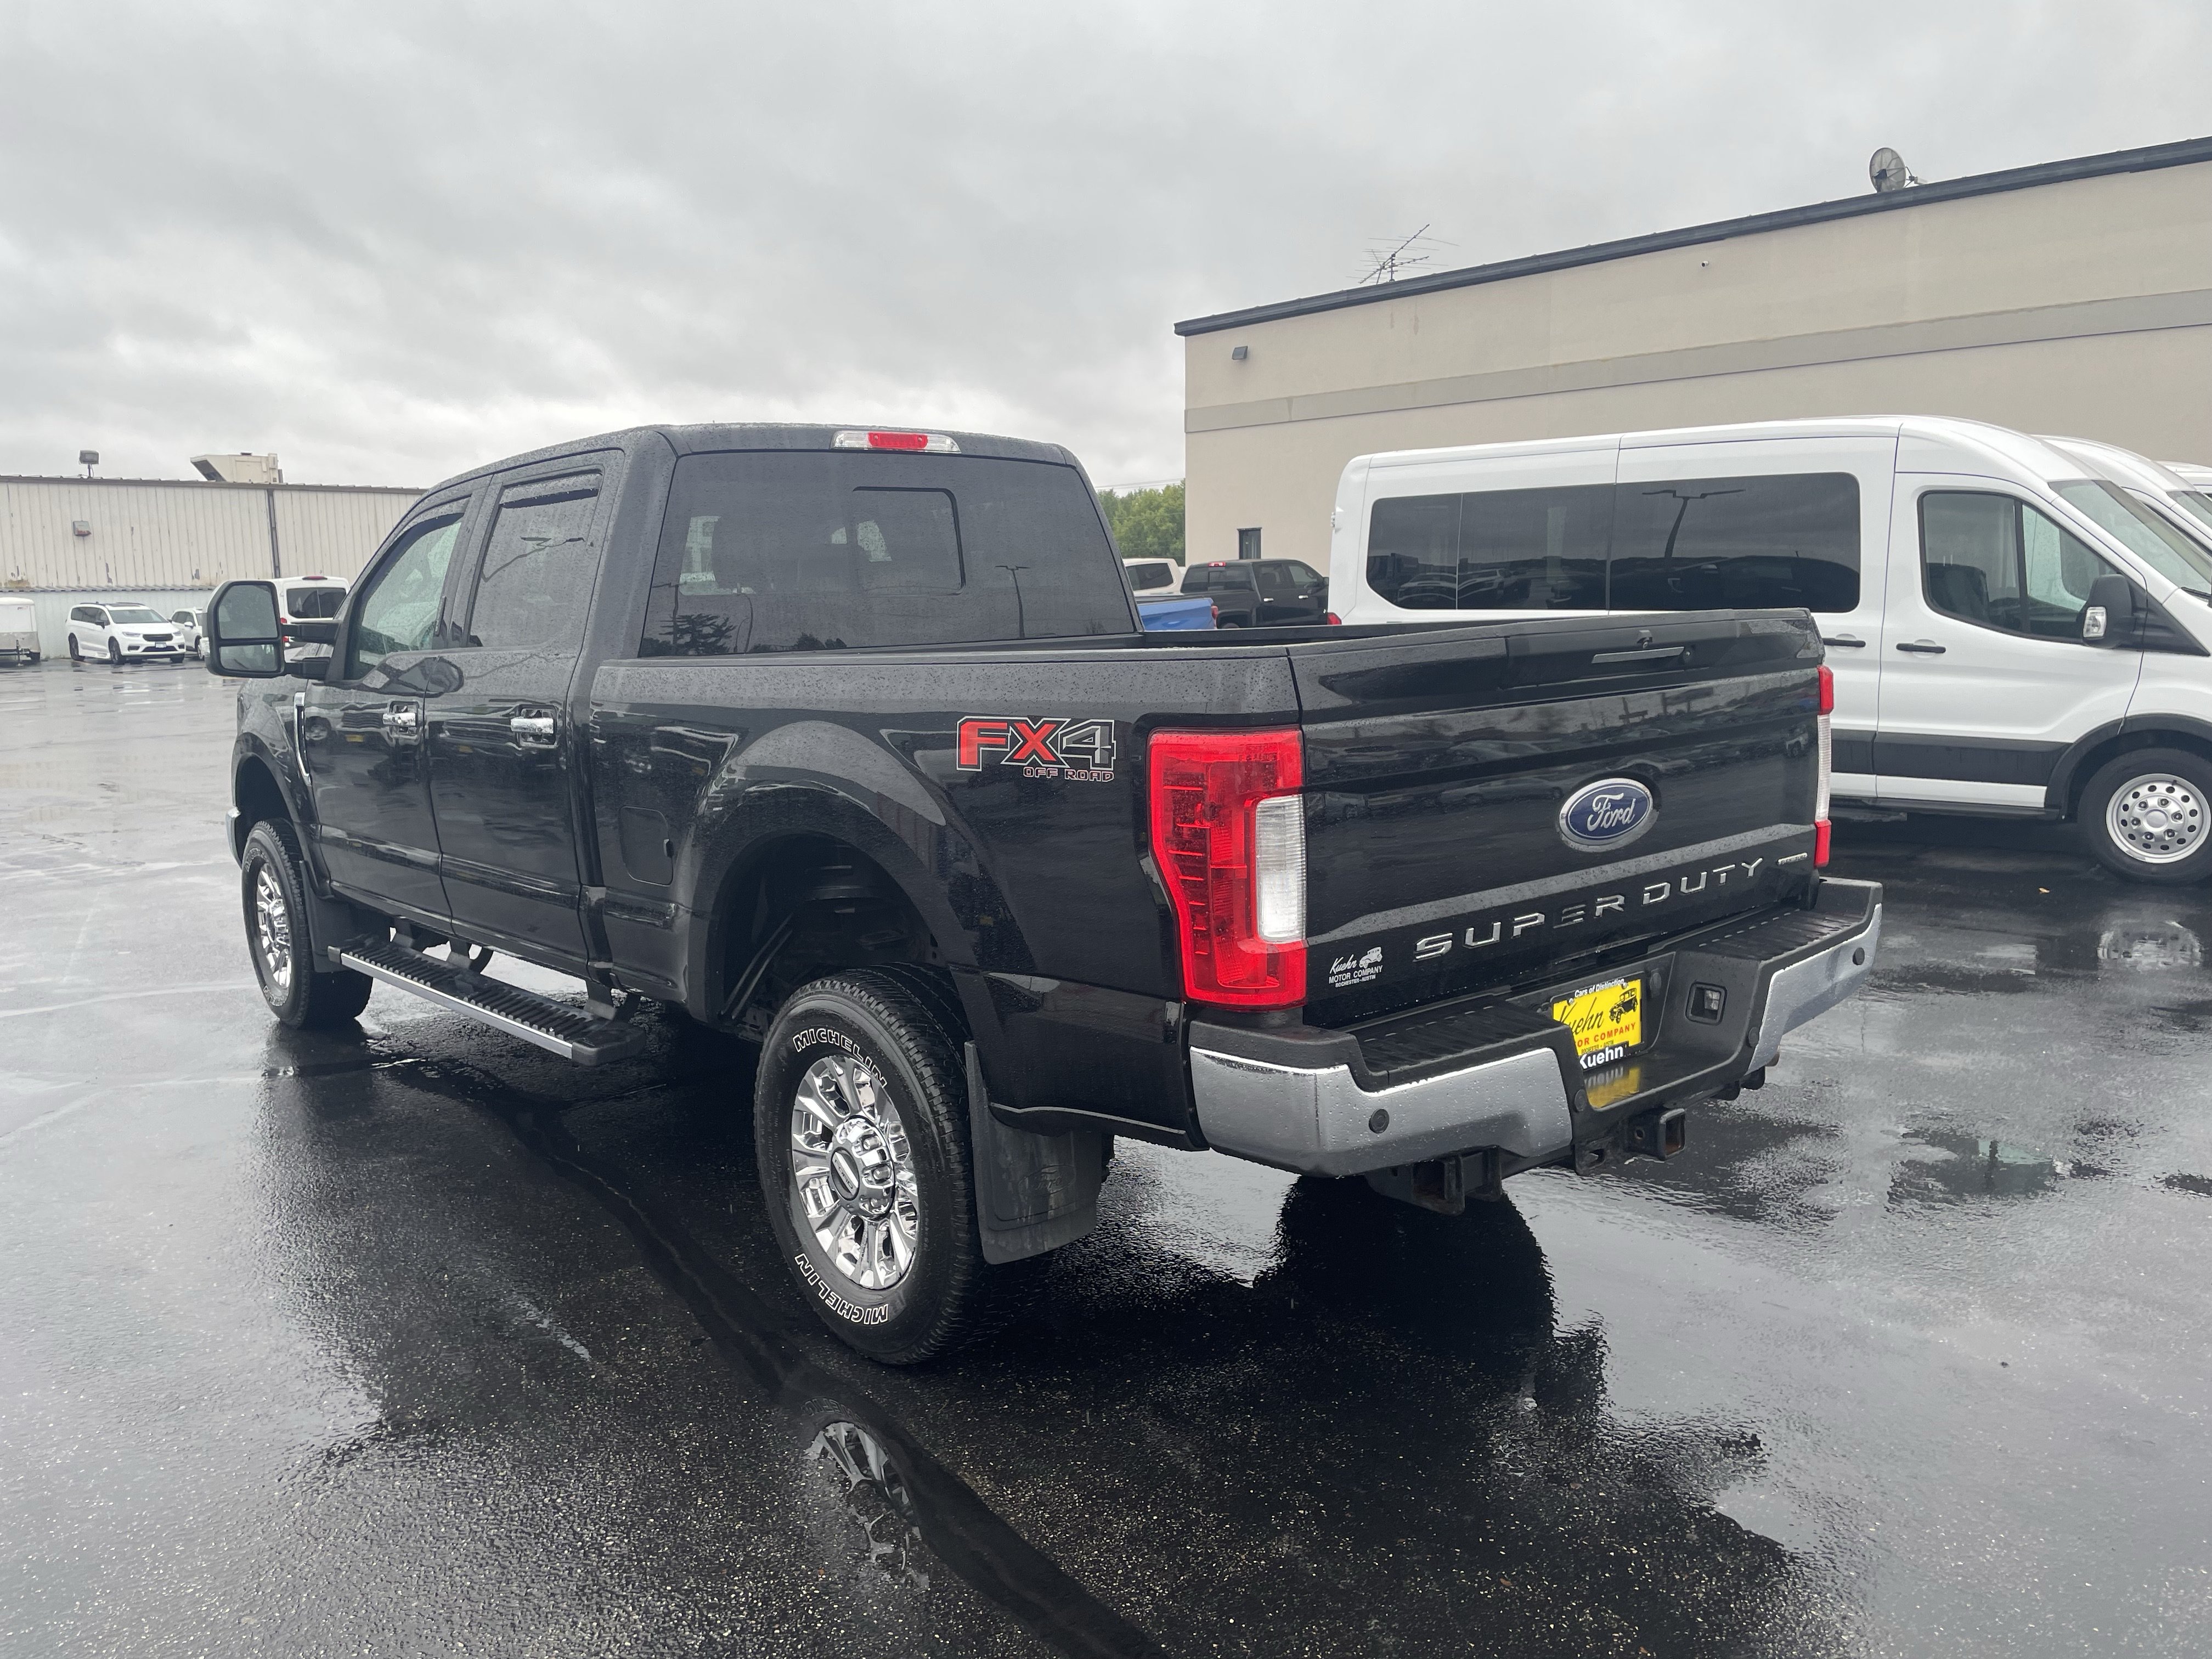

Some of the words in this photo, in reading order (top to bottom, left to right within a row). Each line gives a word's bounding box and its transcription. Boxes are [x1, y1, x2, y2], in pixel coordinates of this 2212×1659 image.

[957, 716, 1116, 771] FX4
[1023, 766, 1058, 778] OFF
[1064, 768, 1114, 782] ROAD
[1587, 792, 1637, 832] Ford
[1414, 894, 1626, 962] SUPER
[1643, 857, 1763, 906] DUTY
[1328, 972, 1351, 984] MOTOR
[1353, 965, 1383, 978] COMPANY
[1329, 954, 1357, 974] Kuehn
[1575, 989, 1588, 998] Cars
[1589, 985, 1595, 994] of
[1595, 978, 1624, 992] Distinction
[1594, 1023, 1636, 1042] COMPANY
[793, 1028, 888, 1088] MICHELIN
[794, 1252, 889, 1325] MICHELIN
